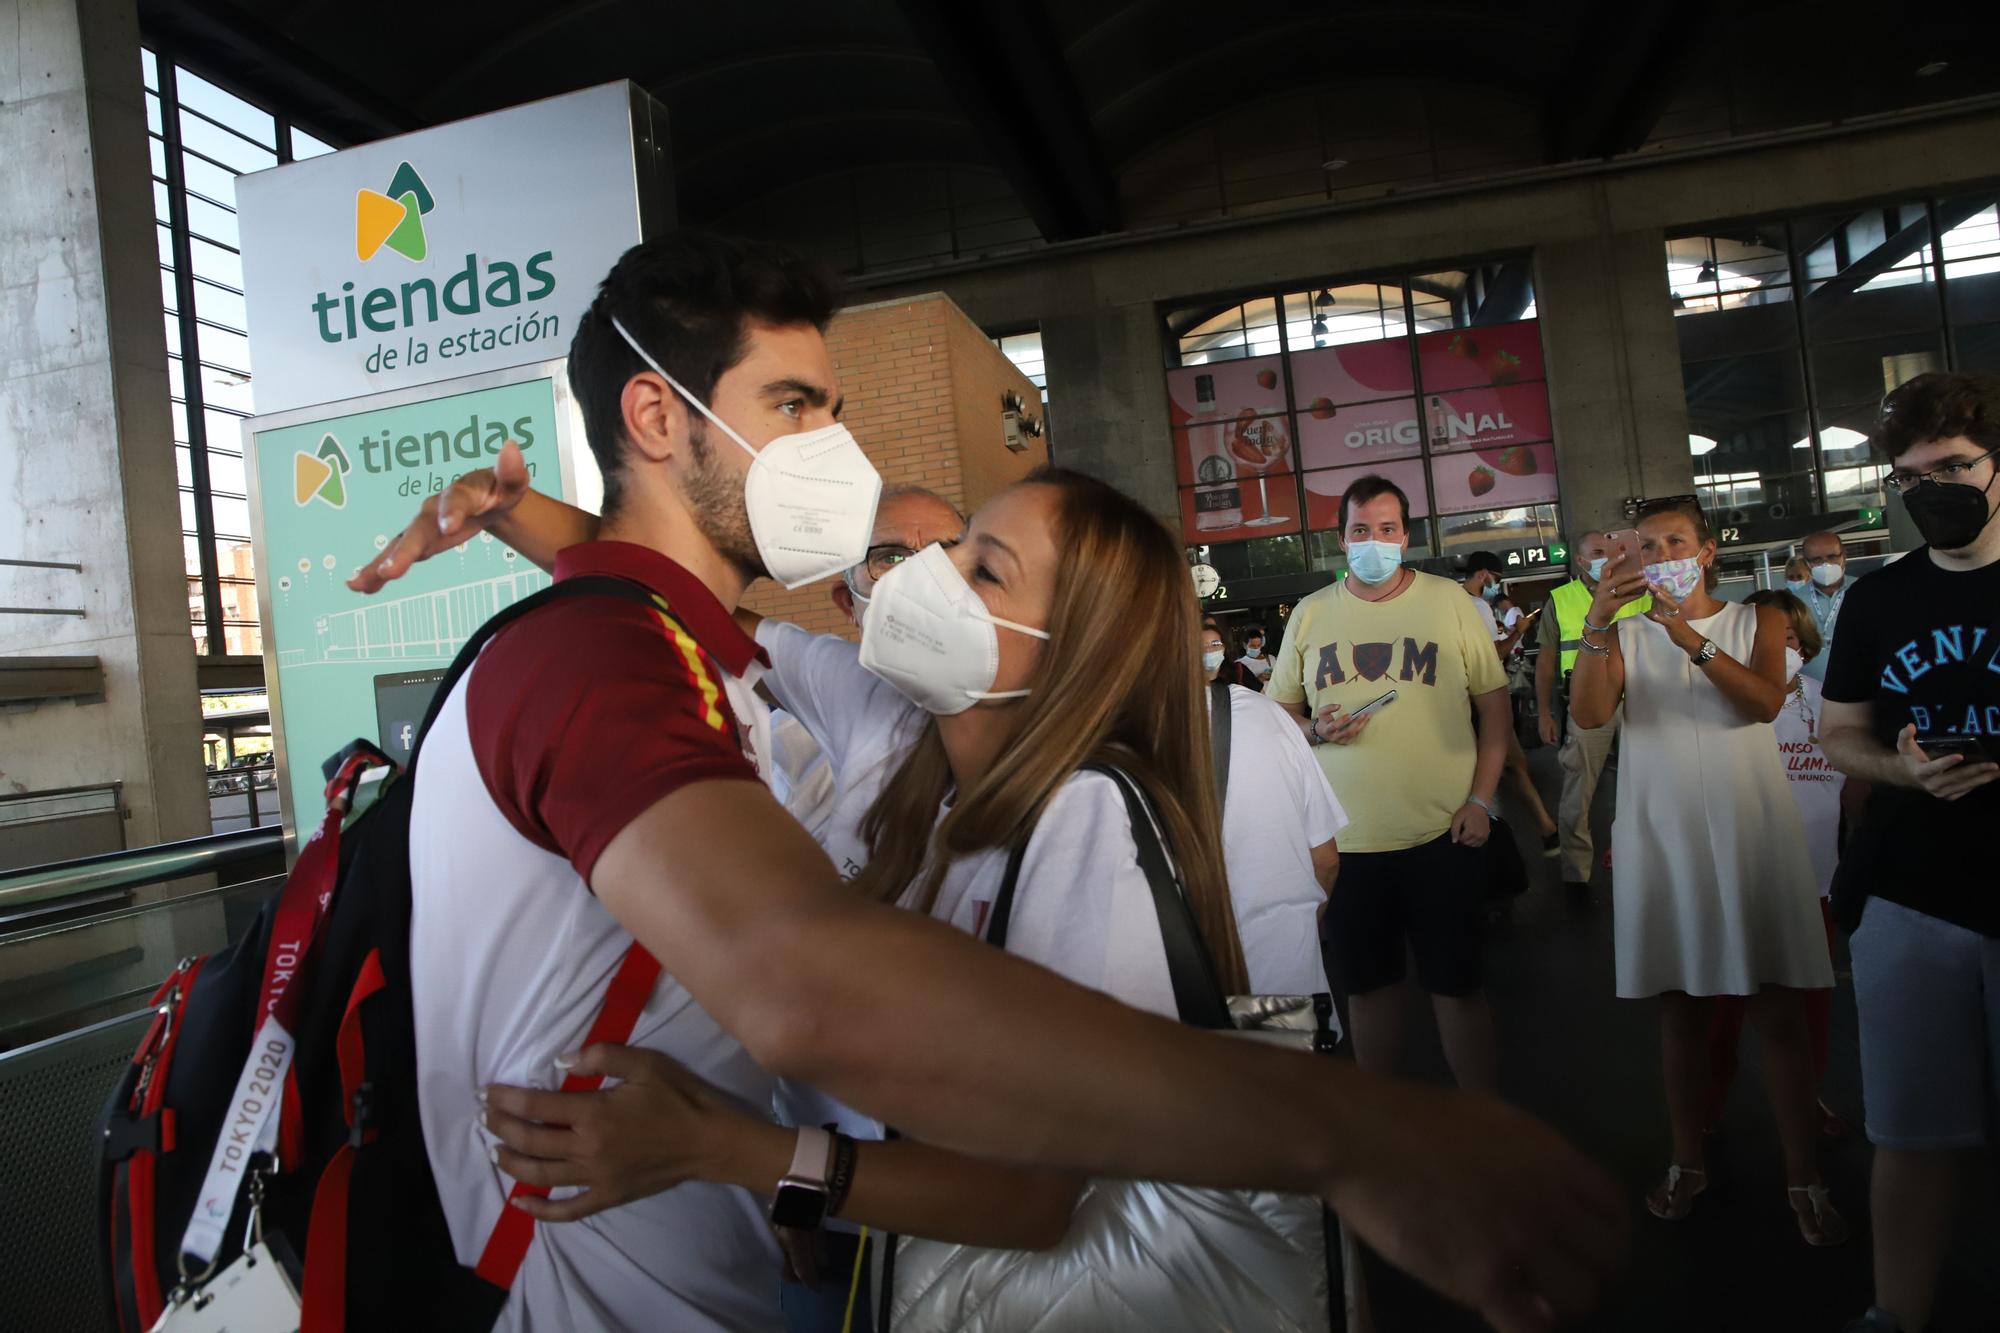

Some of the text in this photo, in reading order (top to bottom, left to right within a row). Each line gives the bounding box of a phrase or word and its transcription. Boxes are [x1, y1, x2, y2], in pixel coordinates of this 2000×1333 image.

[312, 250, 557, 344] tiendas
[365, 311, 559, 374] de la estación
[359, 414, 535, 474] tiendas
[398, 476, 421, 497] de
[428, 472, 443, 493] la
[1527, 548, 1546, 562] P1
[1721, 528, 1739, 541] P2
[1315, 637, 1438, 691] A M
[400, 724, 412, 750] f
[1910, 704, 2000, 735] BAC
[219, 1039, 287, 1173] TOKYO 2020
